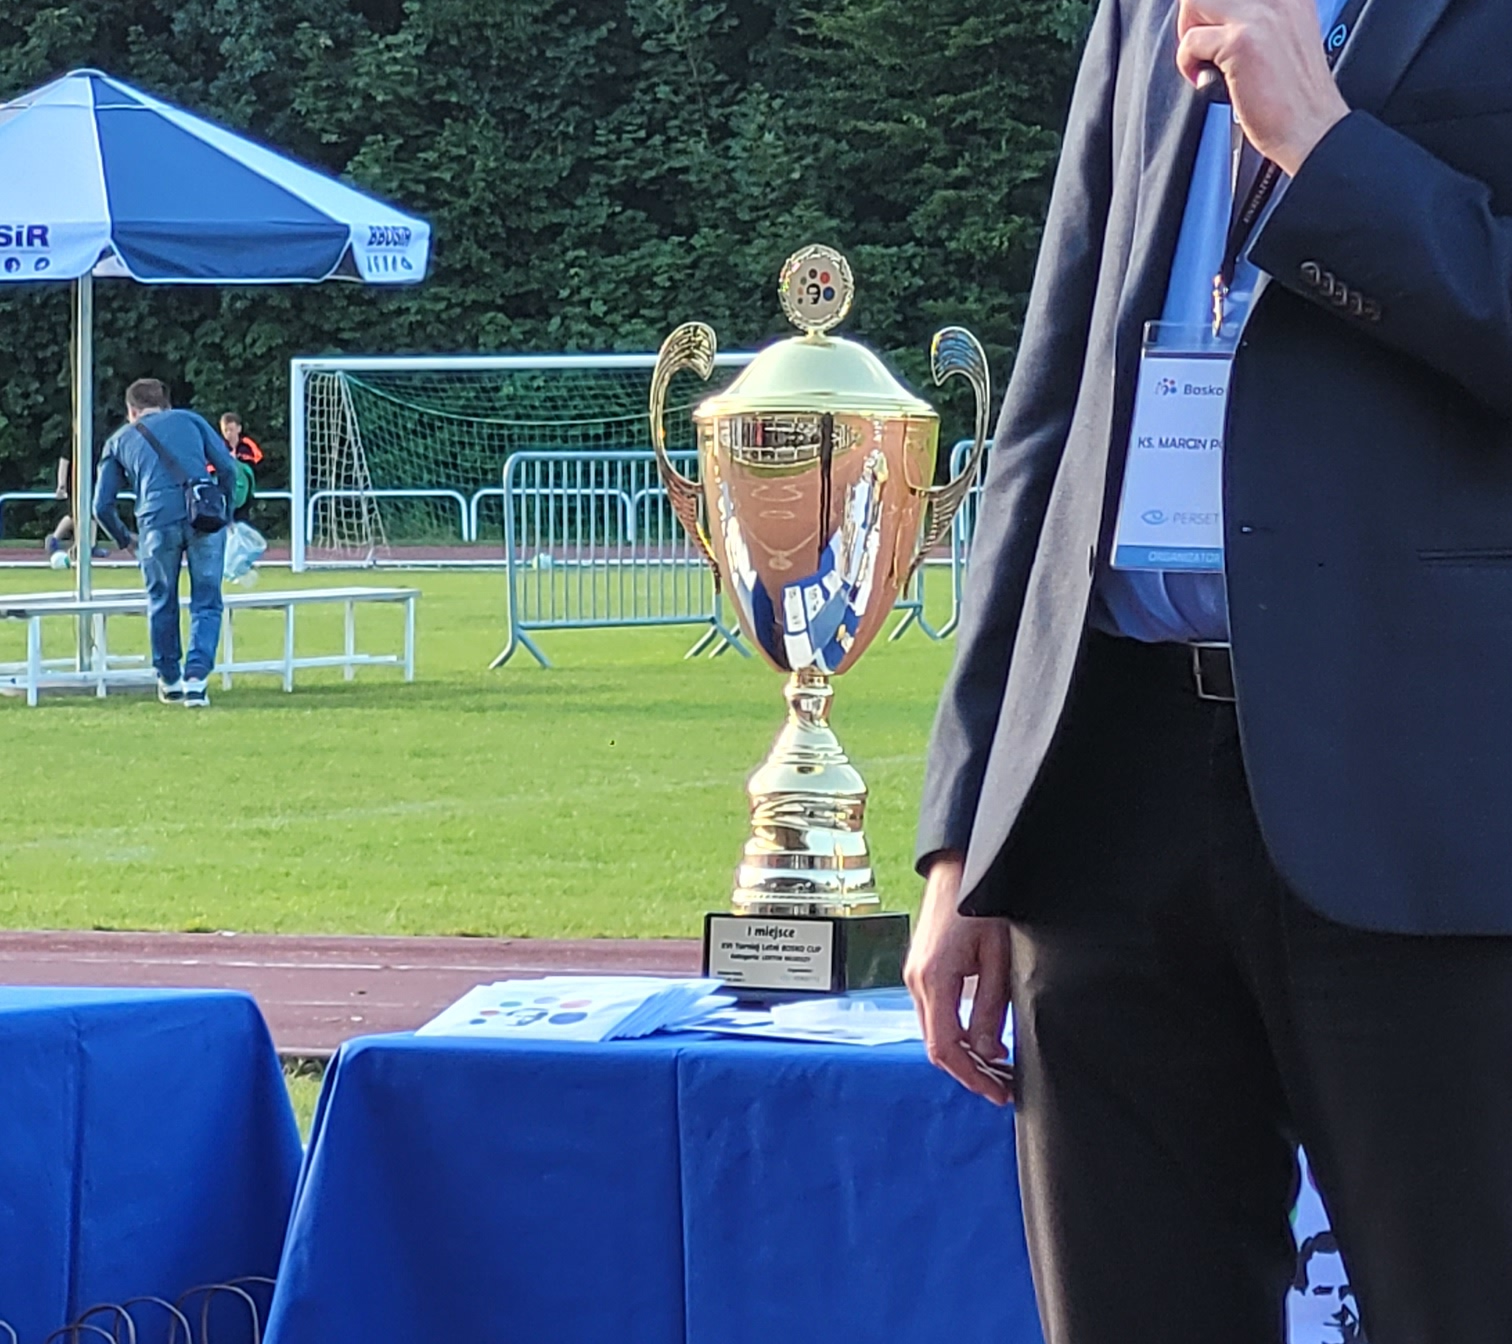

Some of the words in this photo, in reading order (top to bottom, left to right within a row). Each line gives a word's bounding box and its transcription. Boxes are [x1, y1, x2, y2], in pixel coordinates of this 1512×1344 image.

[1183, 383, 1224, 396] Bosko
[1138, 437, 1154, 449] KS.
[1158, 437, 1207, 450] MARCIN
[754, 925, 795, 940] miejsce
[806, 945, 821, 953] CUP
